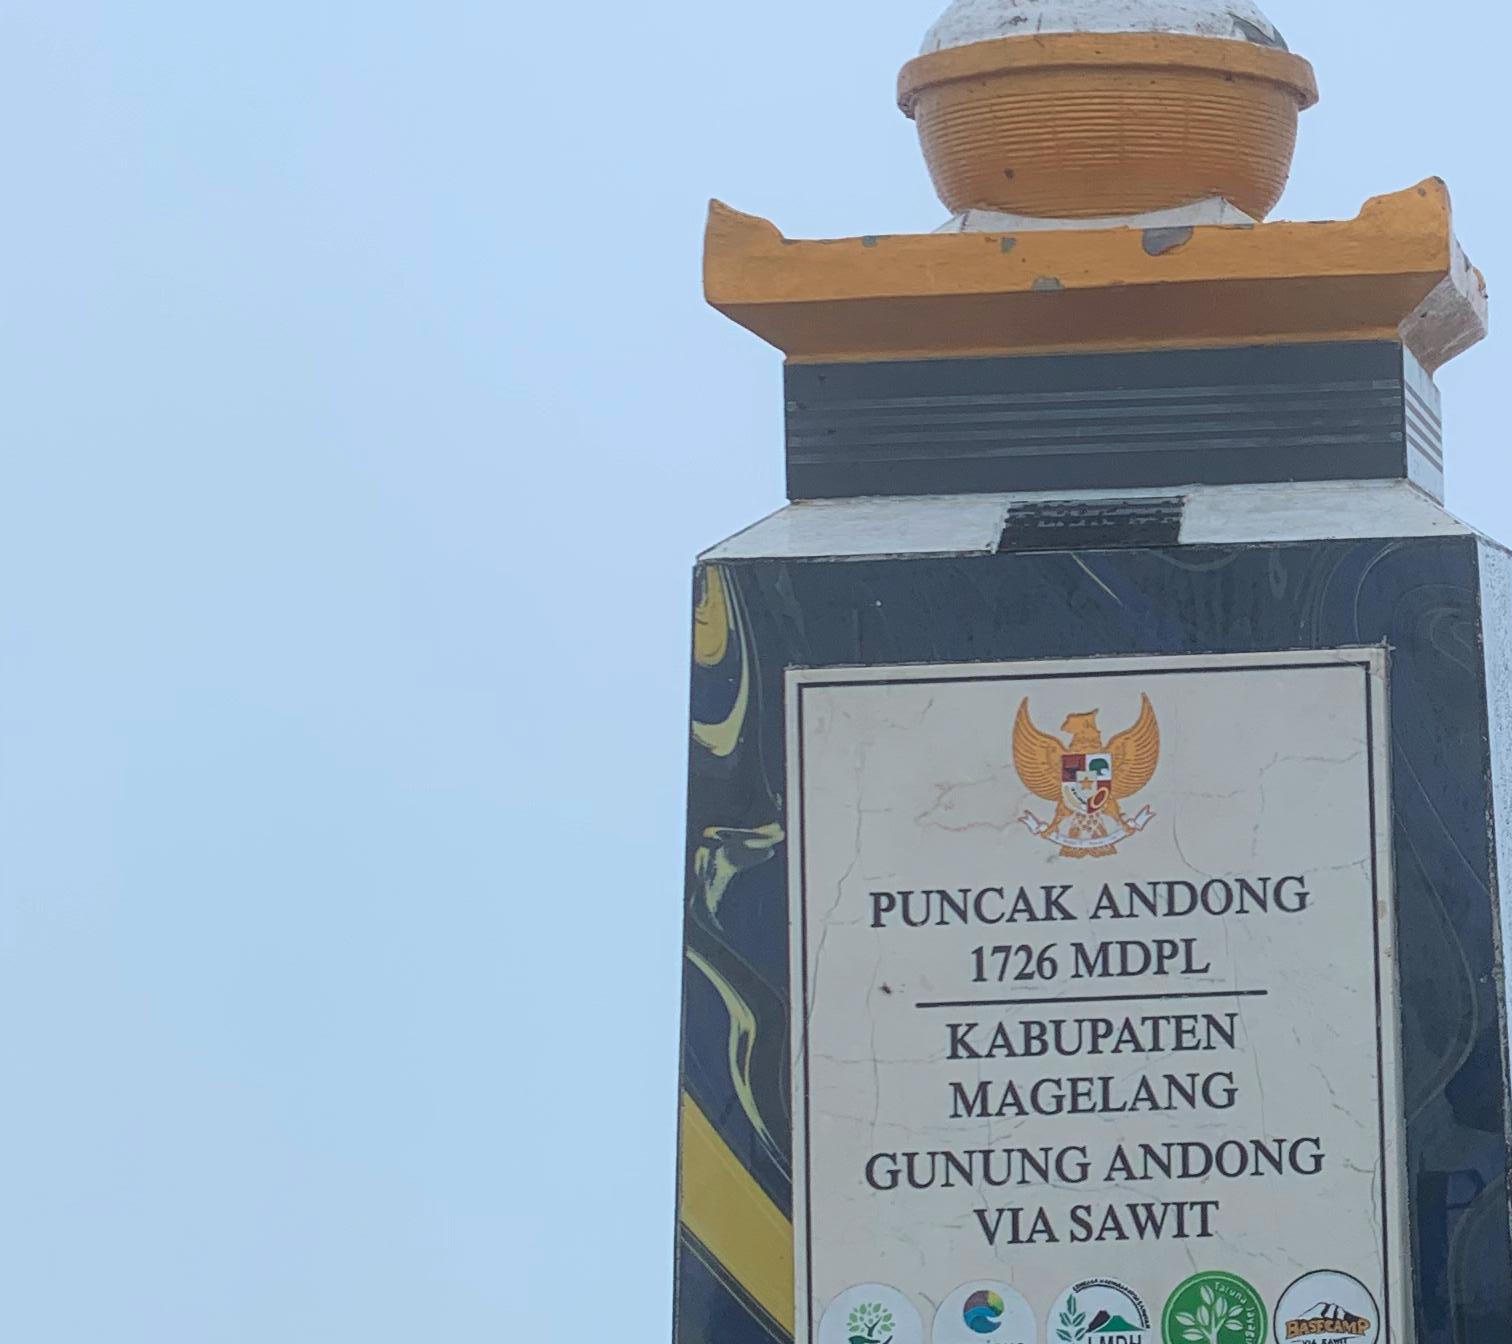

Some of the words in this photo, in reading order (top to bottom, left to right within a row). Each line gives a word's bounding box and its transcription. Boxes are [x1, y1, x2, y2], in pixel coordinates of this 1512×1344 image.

[869, 884, 1078, 929] PUNCAK
[1089, 875, 1310, 920] ANDONG
[971, 943, 1058, 983] 1726
[1070, 937, 1211, 979] MDPL
[945, 1012, 1239, 1061] KABUPATEN
[949, 1071, 1239, 1119] MAGELANG
[864, 1145, 1092, 1191] GUNUNG
[1103, 1136, 1326, 1183] ANDONG
[973, 1206, 1058, 1246] VIA
[1069, 1200, 1220, 1244] SAWIT
[1285, 1316, 1371, 1340] BASECAMP
